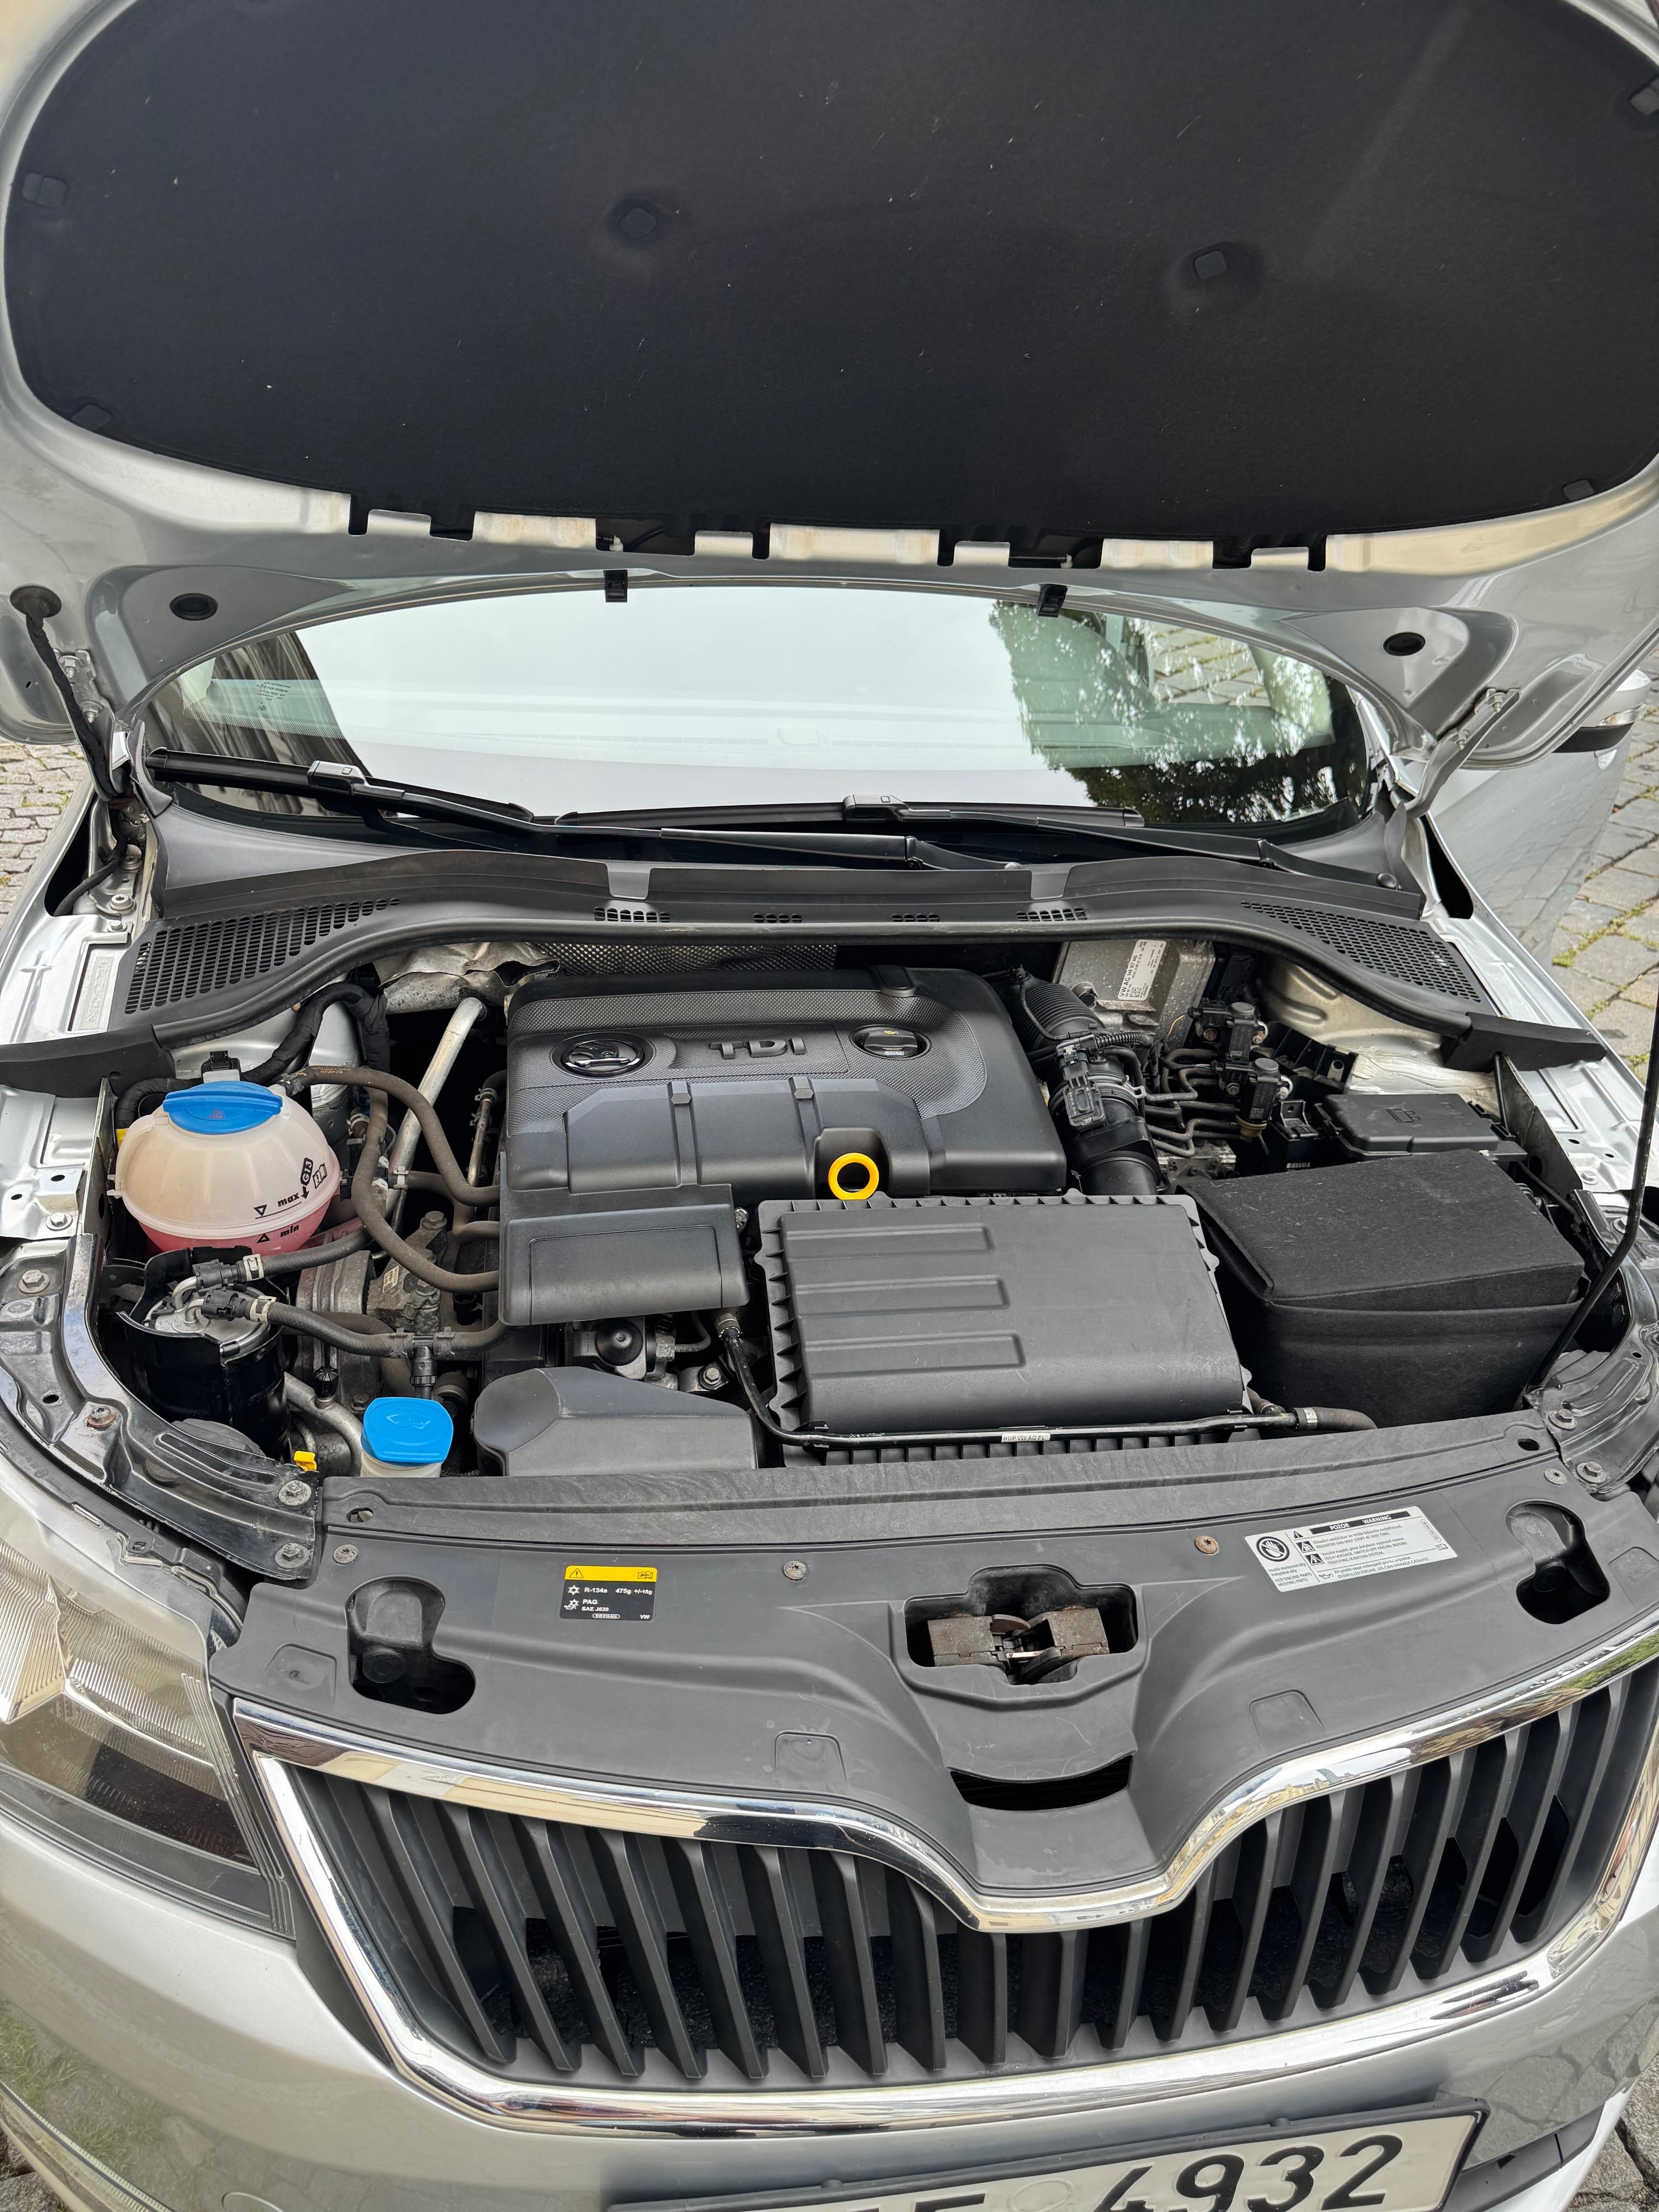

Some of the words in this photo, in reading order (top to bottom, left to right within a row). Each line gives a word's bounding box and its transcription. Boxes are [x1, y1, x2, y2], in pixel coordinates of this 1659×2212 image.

[708, 1037, 807, 1060] TDI
[302, 1161, 312, 1183] G13
[277, 1193, 299, 1207] max
[280, 1225, 299, 1238] min
[1328, 1522, 1350, 1530] POZOR
[1361, 1514, 1392, 1524] WARNING
[1092, 2134, 1403, 2212] 4932
